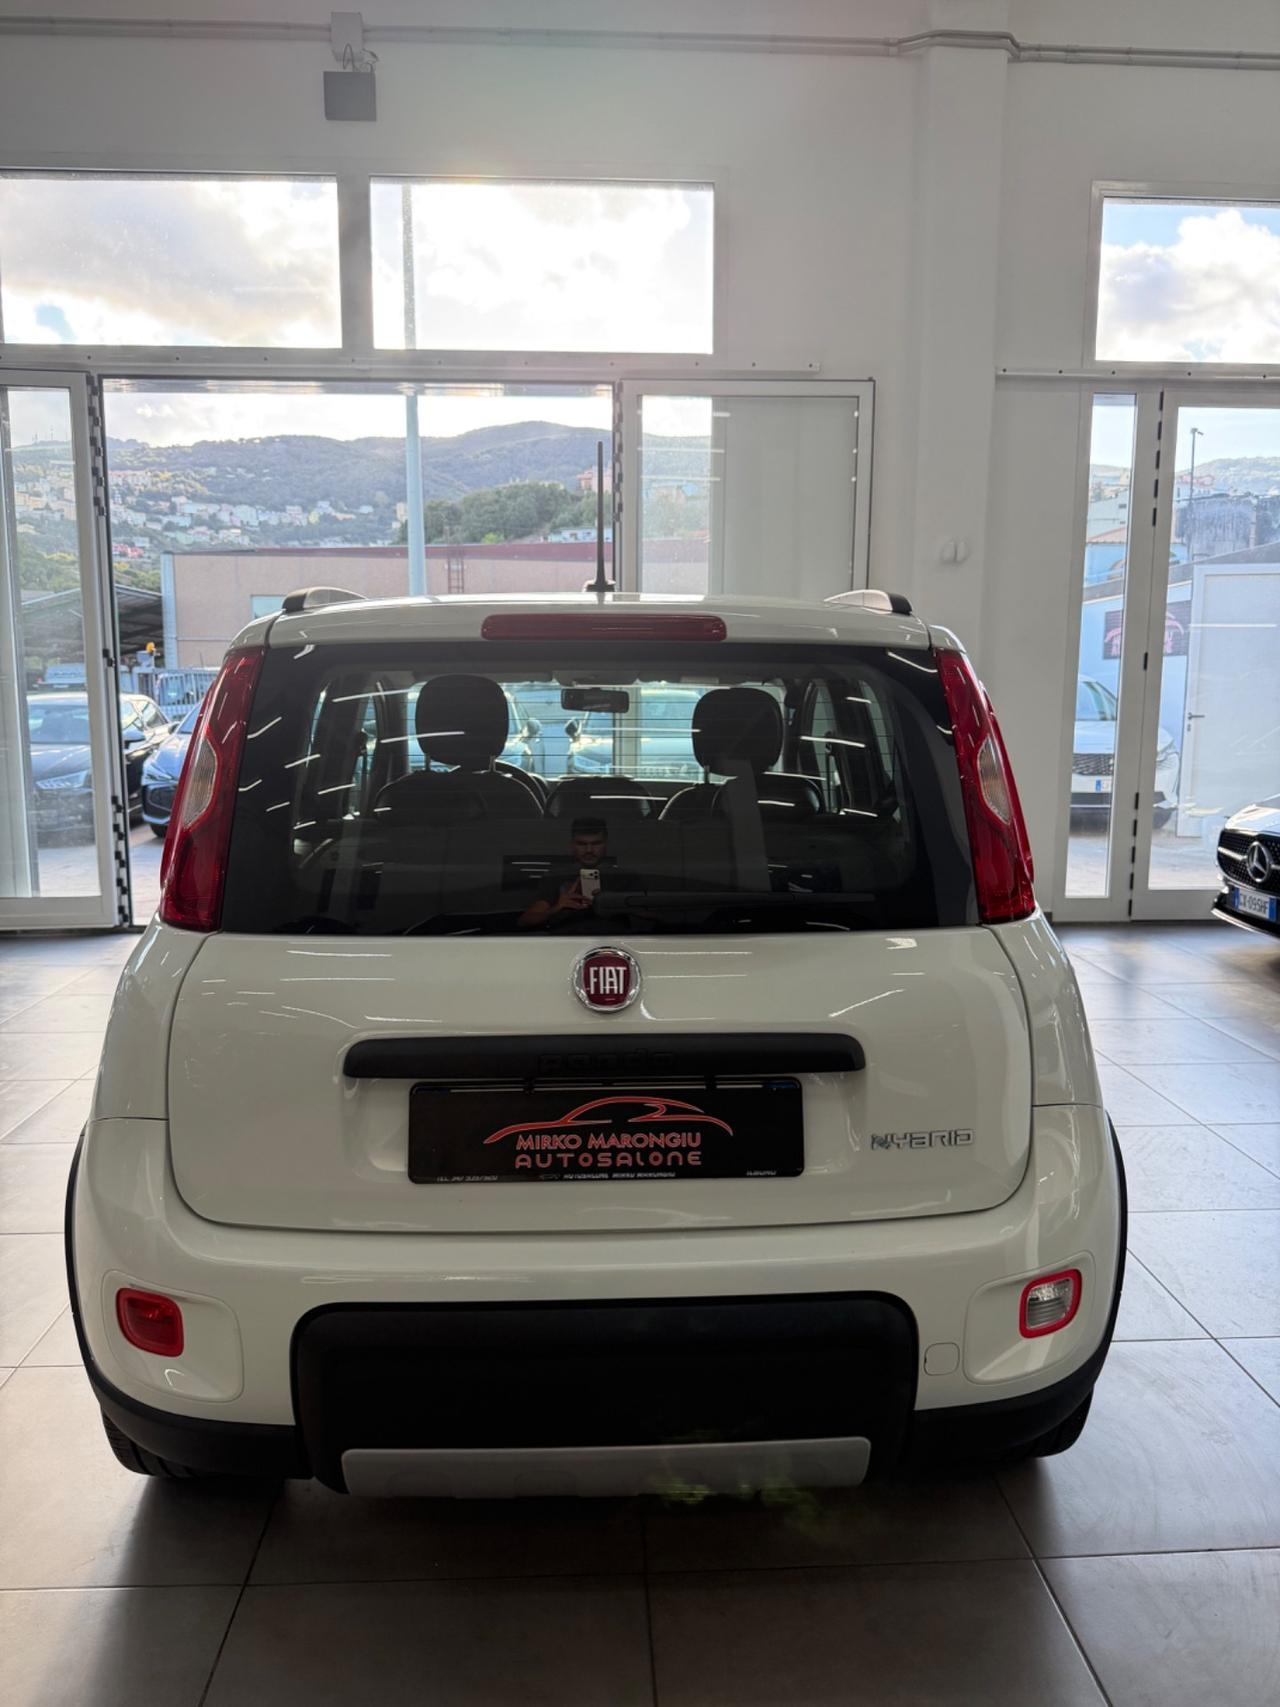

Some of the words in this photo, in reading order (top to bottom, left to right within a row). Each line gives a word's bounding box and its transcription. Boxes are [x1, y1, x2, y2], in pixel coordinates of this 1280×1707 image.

[589, 966, 627, 994] FIAT
[516, 1133, 582, 1150] MIRKO
[587, 1132, 701, 1149] MARONGIU
[871, 1128, 975, 1150] HYBRID
[515, 1151, 702, 1169] AUTOSALONE
